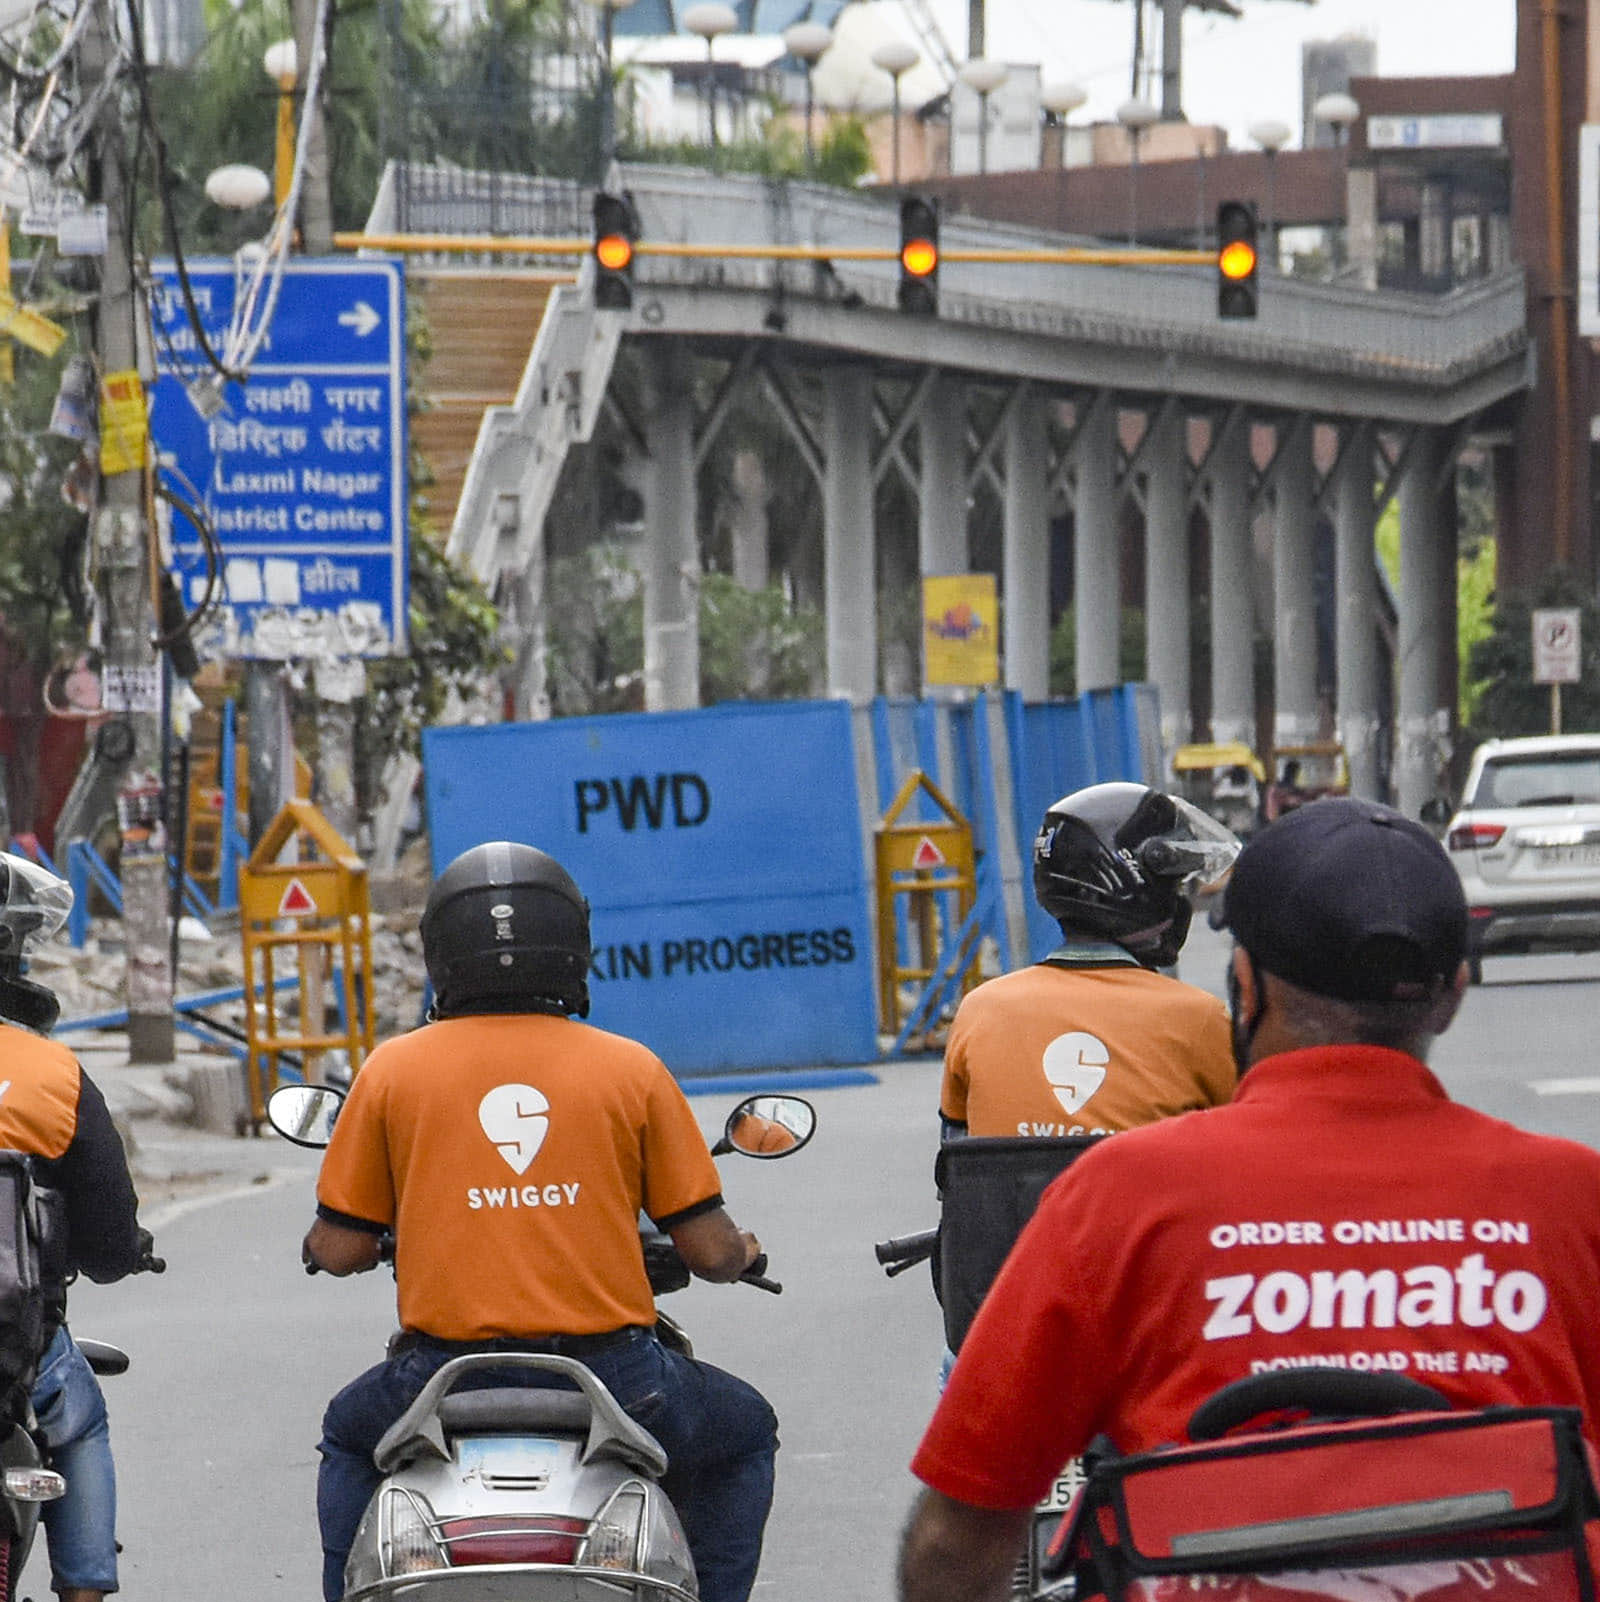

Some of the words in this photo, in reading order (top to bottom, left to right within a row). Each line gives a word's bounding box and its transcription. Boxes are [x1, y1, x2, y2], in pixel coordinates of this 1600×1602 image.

[324, 386, 381, 413] नगर
[215, 468, 294, 494] Laxmi
[302, 468, 381, 498] Nagar
[207, 505, 288, 531] istrict
[294, 504, 383, 531] Centre
[575, 772, 711, 833] PWD
[662, 928, 855, 976] PROGRESS
[467, 1182, 581, 1209] SWIGGY
[1210, 1221, 1324, 1249] ORDER
[1333, 1219, 1465, 1245] ONLINE
[1472, 1219, 1529, 1244] ON
[1202, 1253, 1548, 1341] zomato
[1413, 1352, 1458, 1373] THE
[1465, 1353, 1509, 1374] APP
